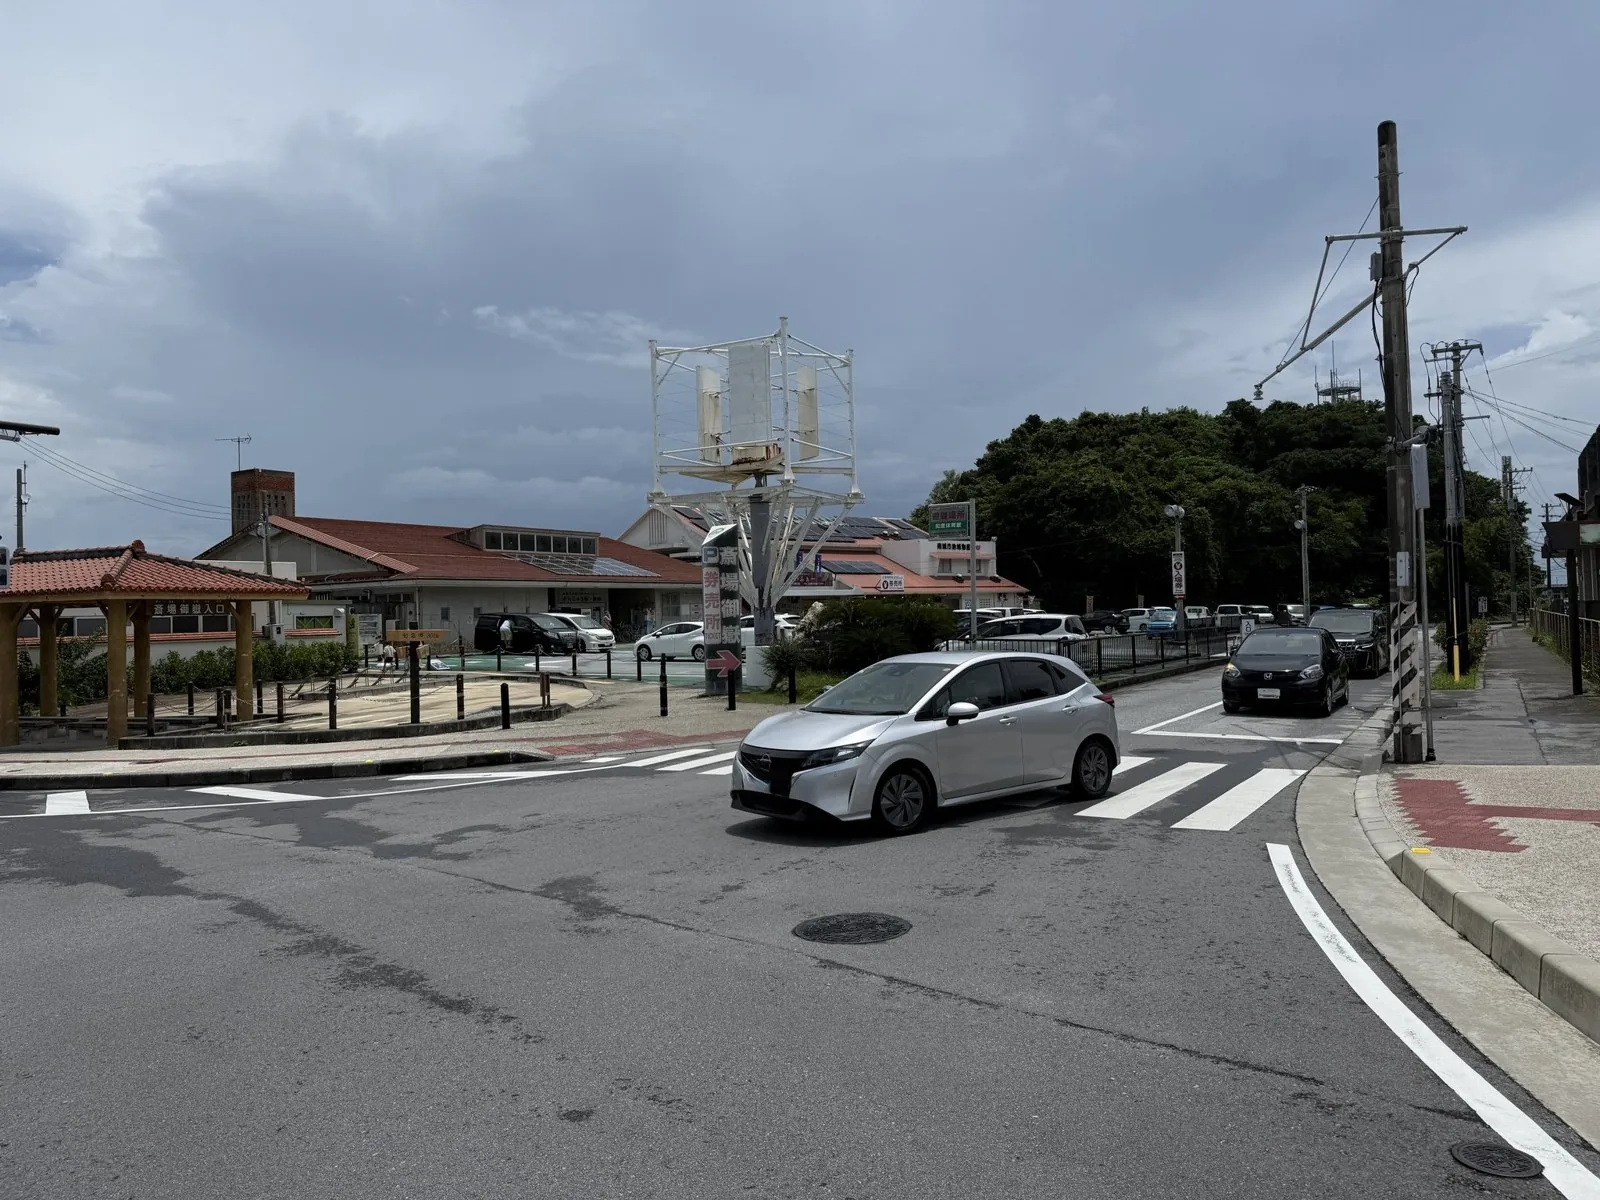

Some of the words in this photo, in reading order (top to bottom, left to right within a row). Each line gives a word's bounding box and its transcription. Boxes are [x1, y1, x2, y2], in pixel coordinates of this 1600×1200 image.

[704, 549, 717, 561] P
[704, 571, 720, 630] 券売所
[1245, 621, 1252, 632] 入口
